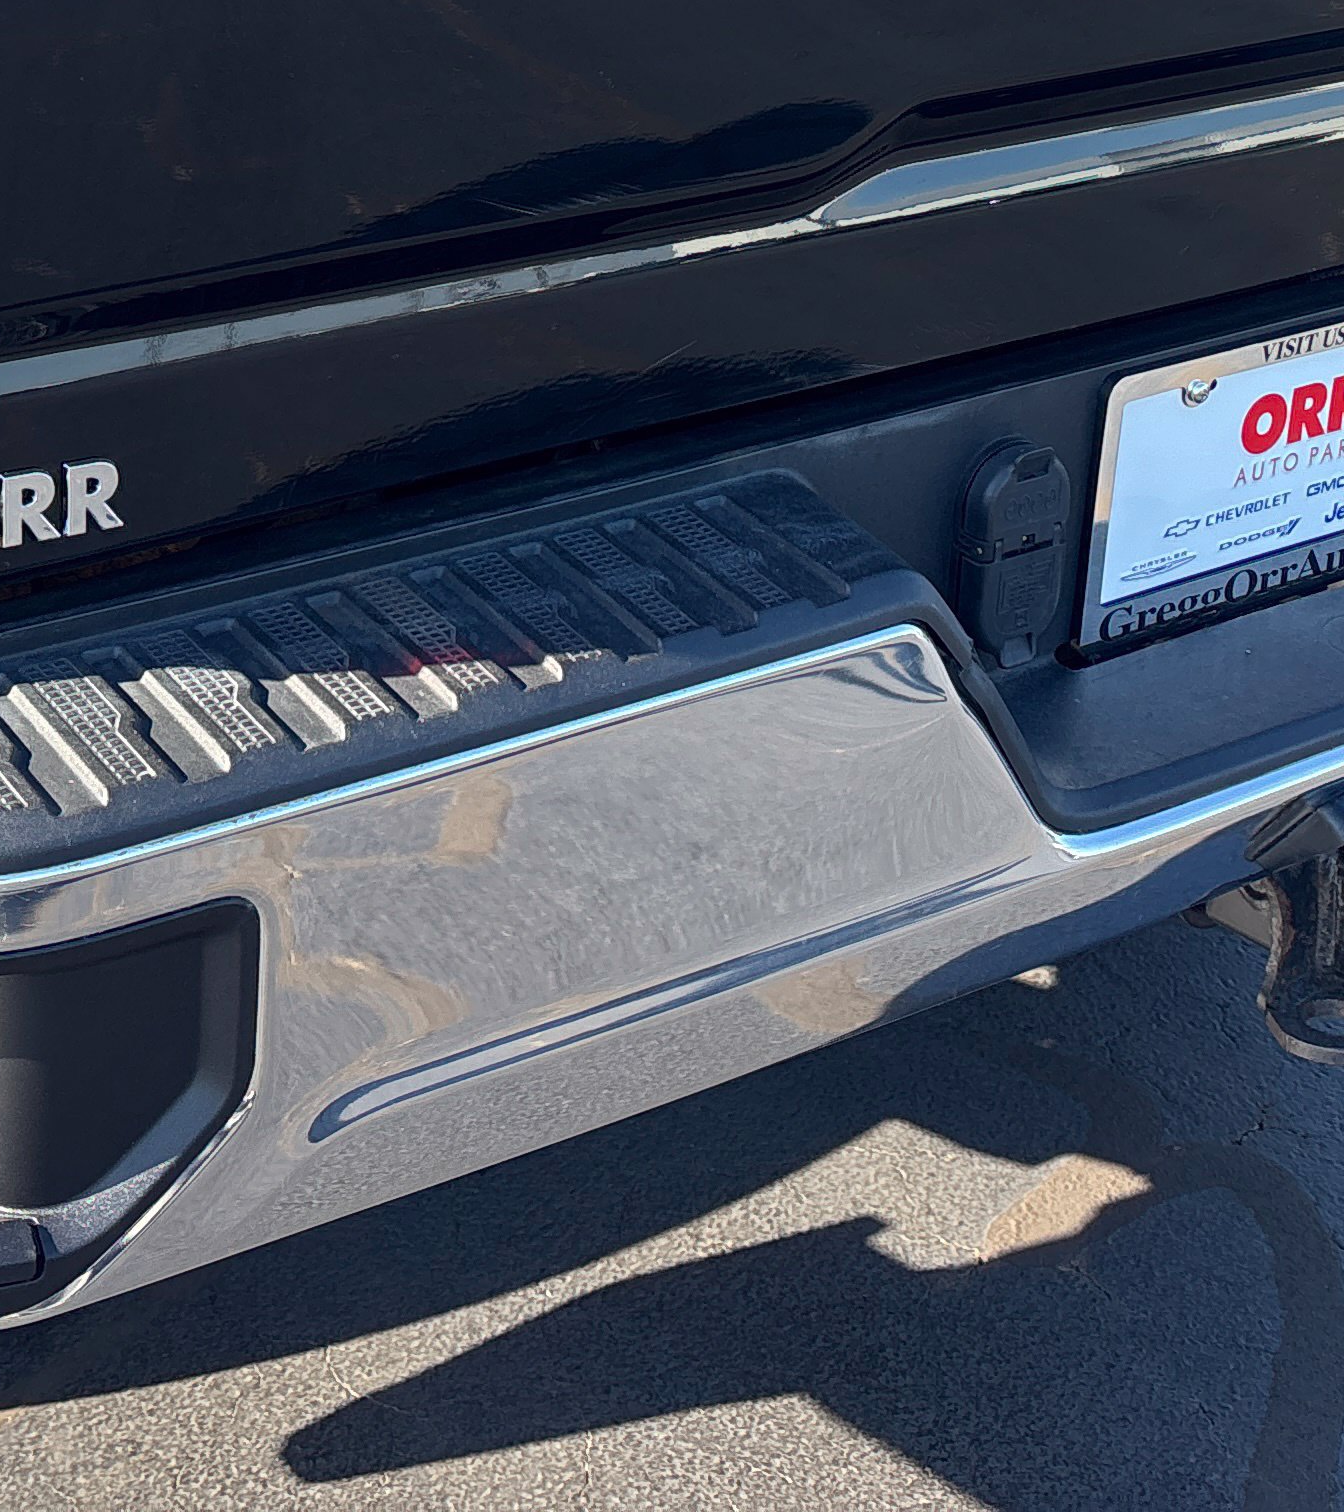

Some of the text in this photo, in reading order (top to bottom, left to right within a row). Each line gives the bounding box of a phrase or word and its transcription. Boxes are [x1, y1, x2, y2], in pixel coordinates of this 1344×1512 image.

[1262, 332, 1319, 363] VISIT
[1233, 452, 1299, 488] AUTO
[1206, 491, 1291, 527] CHEVROLET
[1219, 523, 1289, 550] DODGE
[1131, 550, 1188, 572] CHRYSLER
